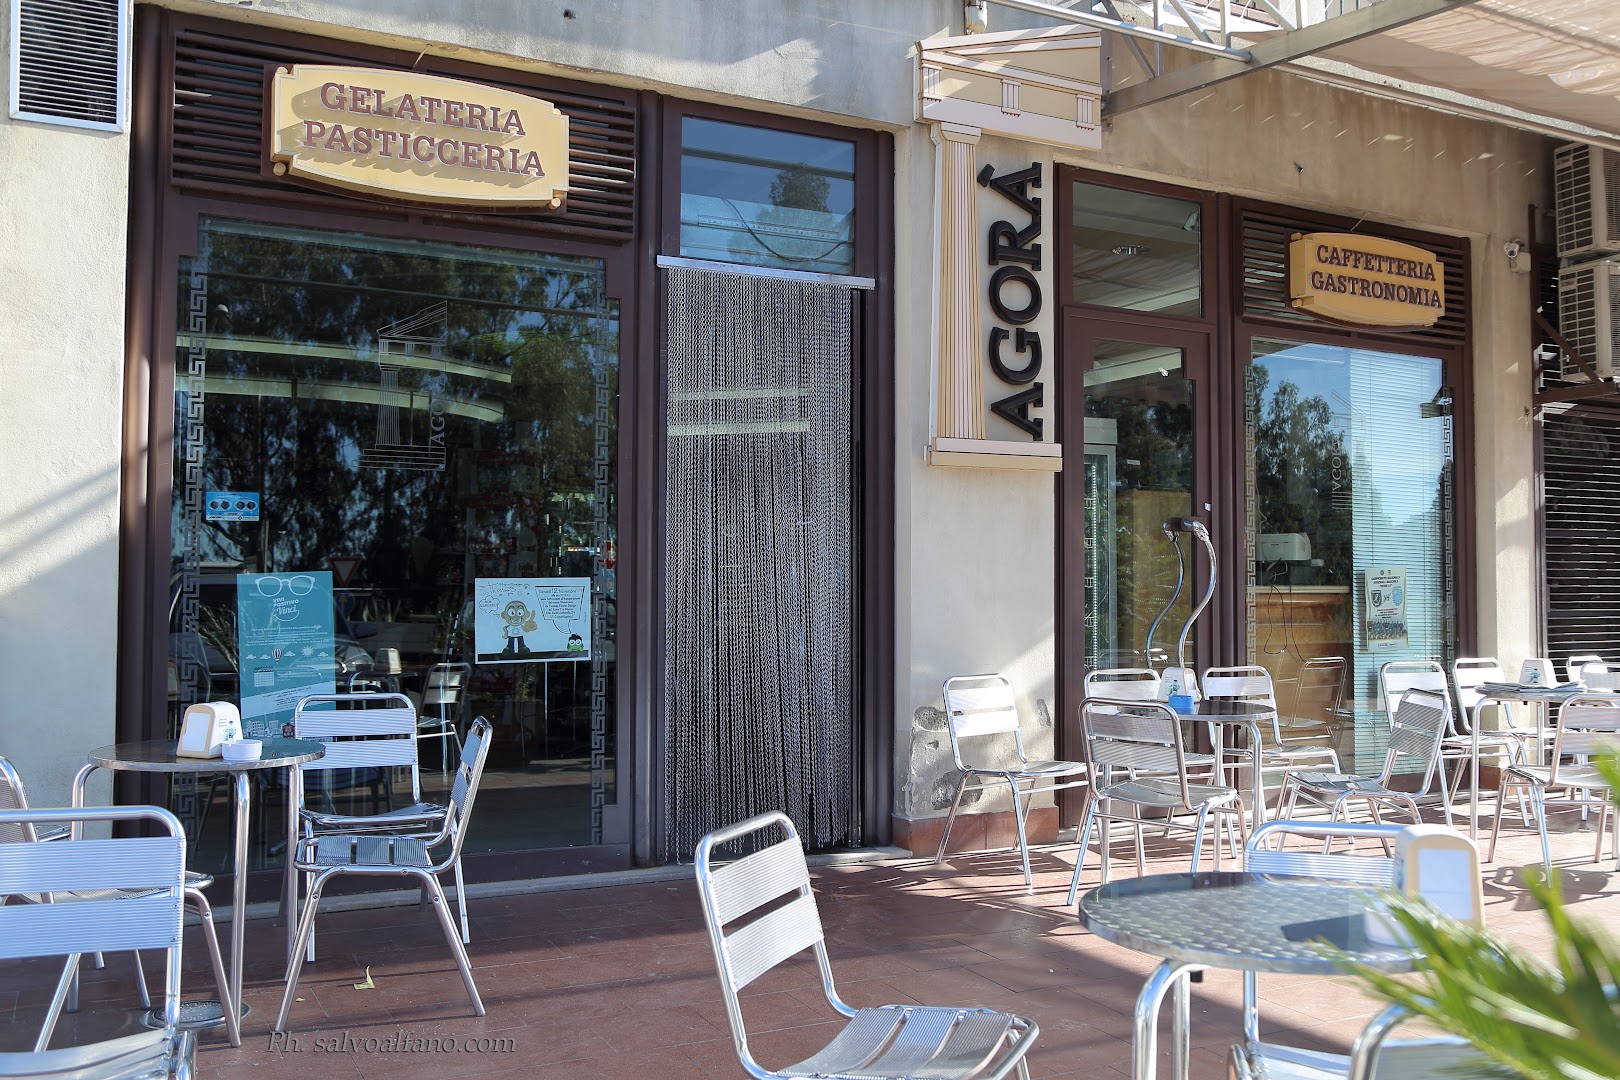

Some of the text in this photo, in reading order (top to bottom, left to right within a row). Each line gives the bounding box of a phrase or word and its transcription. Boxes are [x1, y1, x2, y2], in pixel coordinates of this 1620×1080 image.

[320, 82, 526, 136] GELATERIA
[302, 120, 546, 177] PASTICCERIA
[1310, 271, 1442, 308] GASTRONOMIA
[1316, 244, 1437, 282] CAFFETTERIA
[977, 162, 1044, 442] AGORÀ
